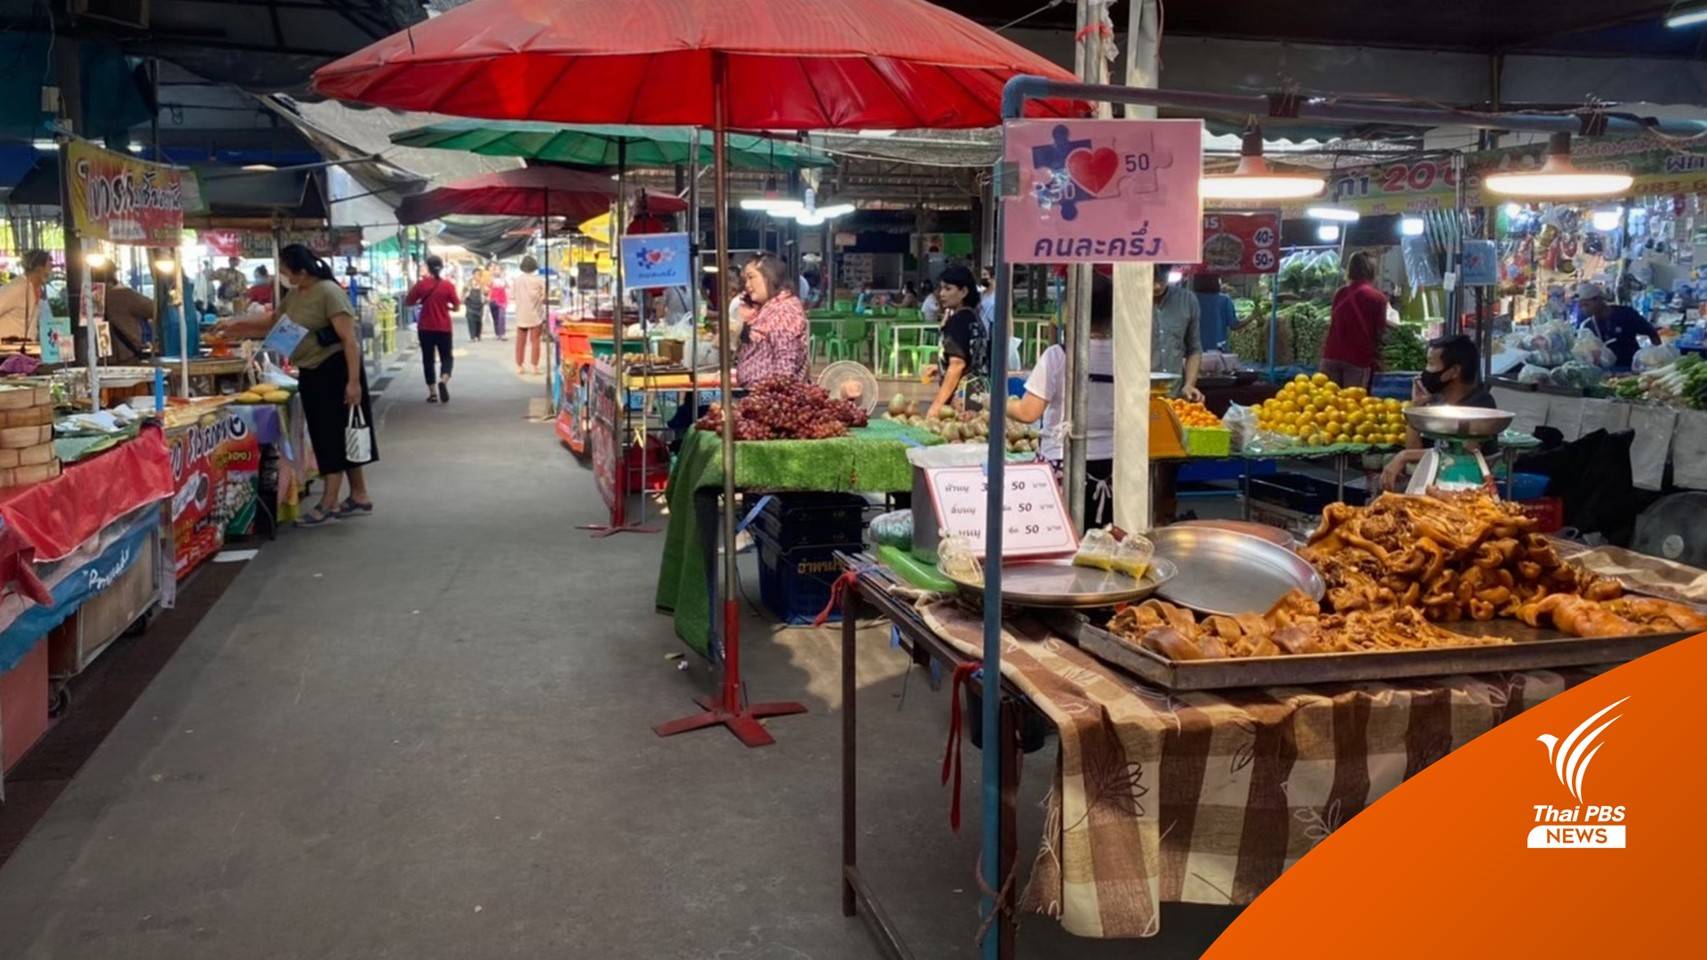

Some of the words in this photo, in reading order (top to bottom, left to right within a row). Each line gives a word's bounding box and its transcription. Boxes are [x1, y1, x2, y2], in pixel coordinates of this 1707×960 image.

[1125, 153, 1150, 173] 50
[1383, 163, 1436, 193] 20
[1033, 221, 1163, 257] คนละครึ่ง
[1011, 481, 1026, 490] 50
[1018, 503, 1033, 512] 50
[1025, 524, 1040, 534] 50
